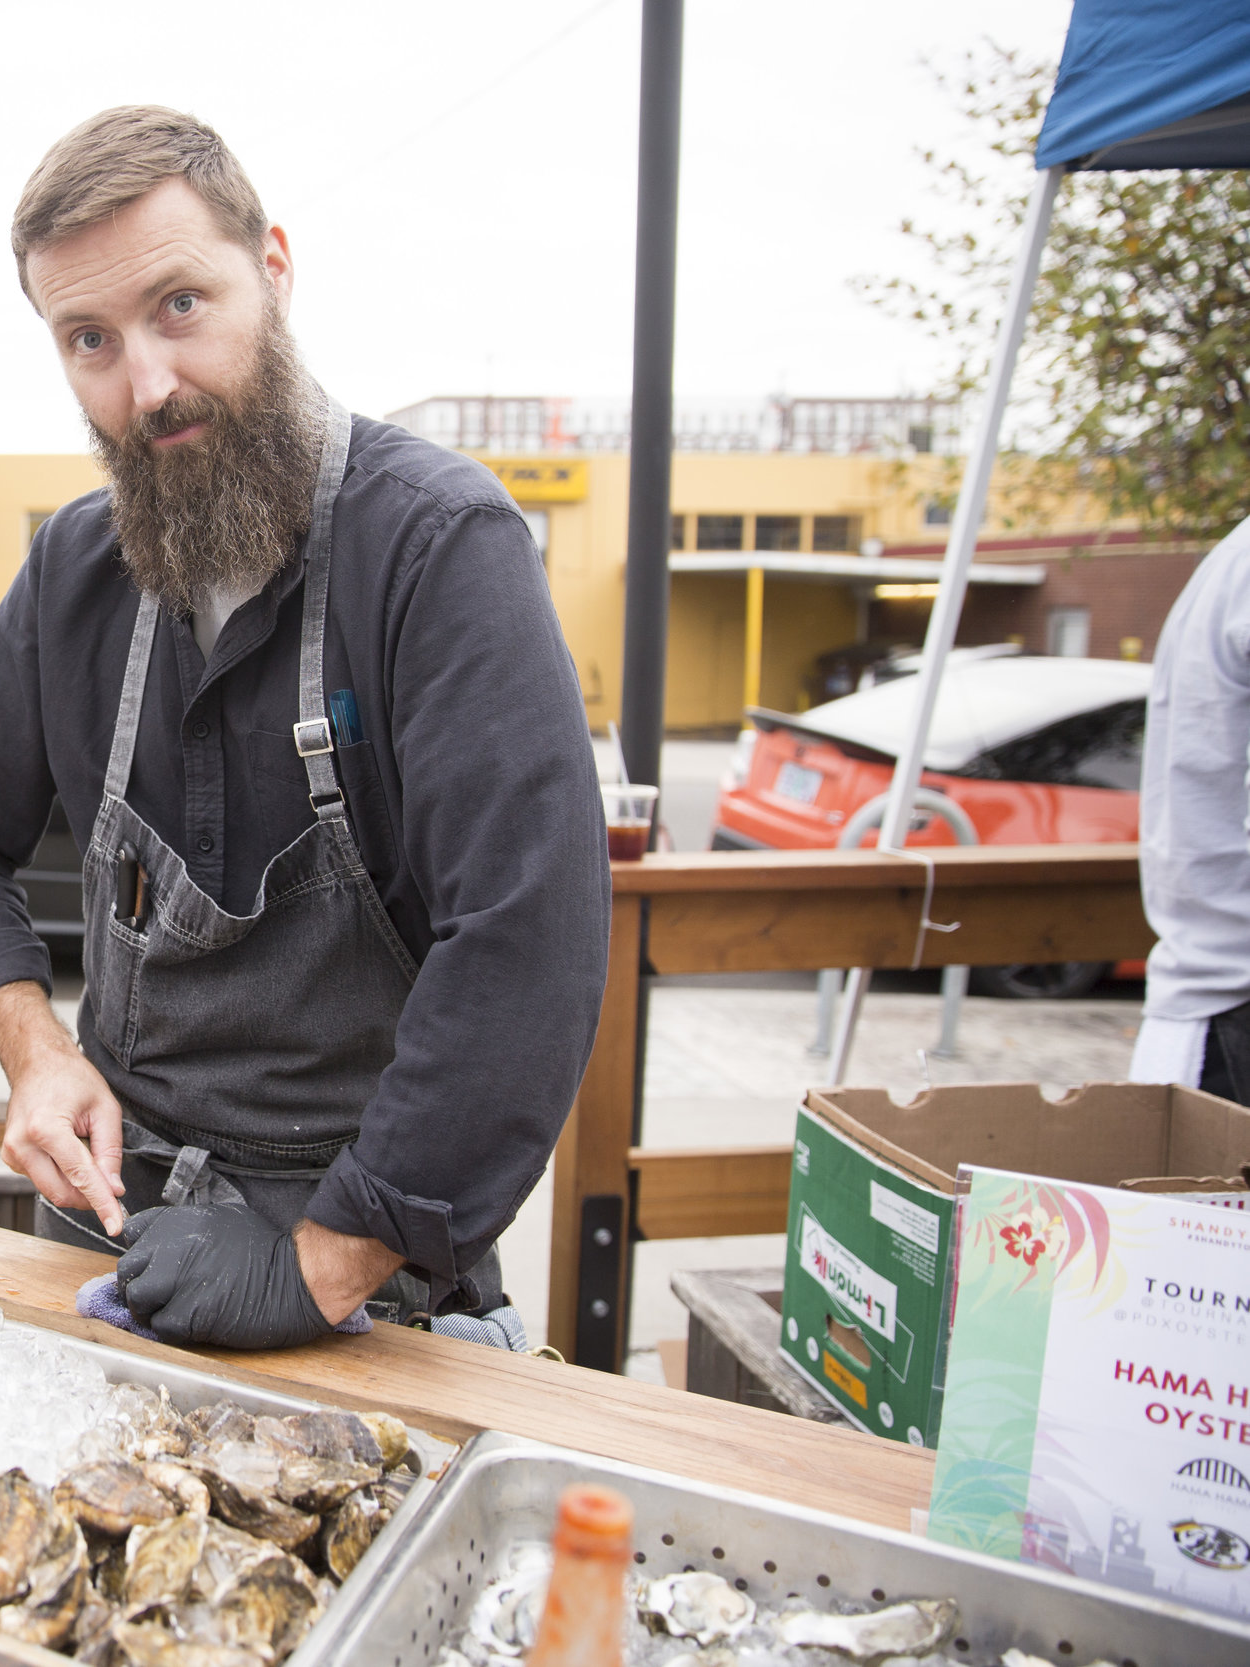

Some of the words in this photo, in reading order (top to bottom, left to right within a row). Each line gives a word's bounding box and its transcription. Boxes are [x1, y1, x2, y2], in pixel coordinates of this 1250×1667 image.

[1169, 1217, 1246, 1239] SHANDY
[1145, 1277, 1250, 1312] TOURN
[1114, 1359, 1213, 1401] HAMA
[1227, 1384, 1248, 1409] H
[1145, 1403, 1250, 1446] OYSTE
